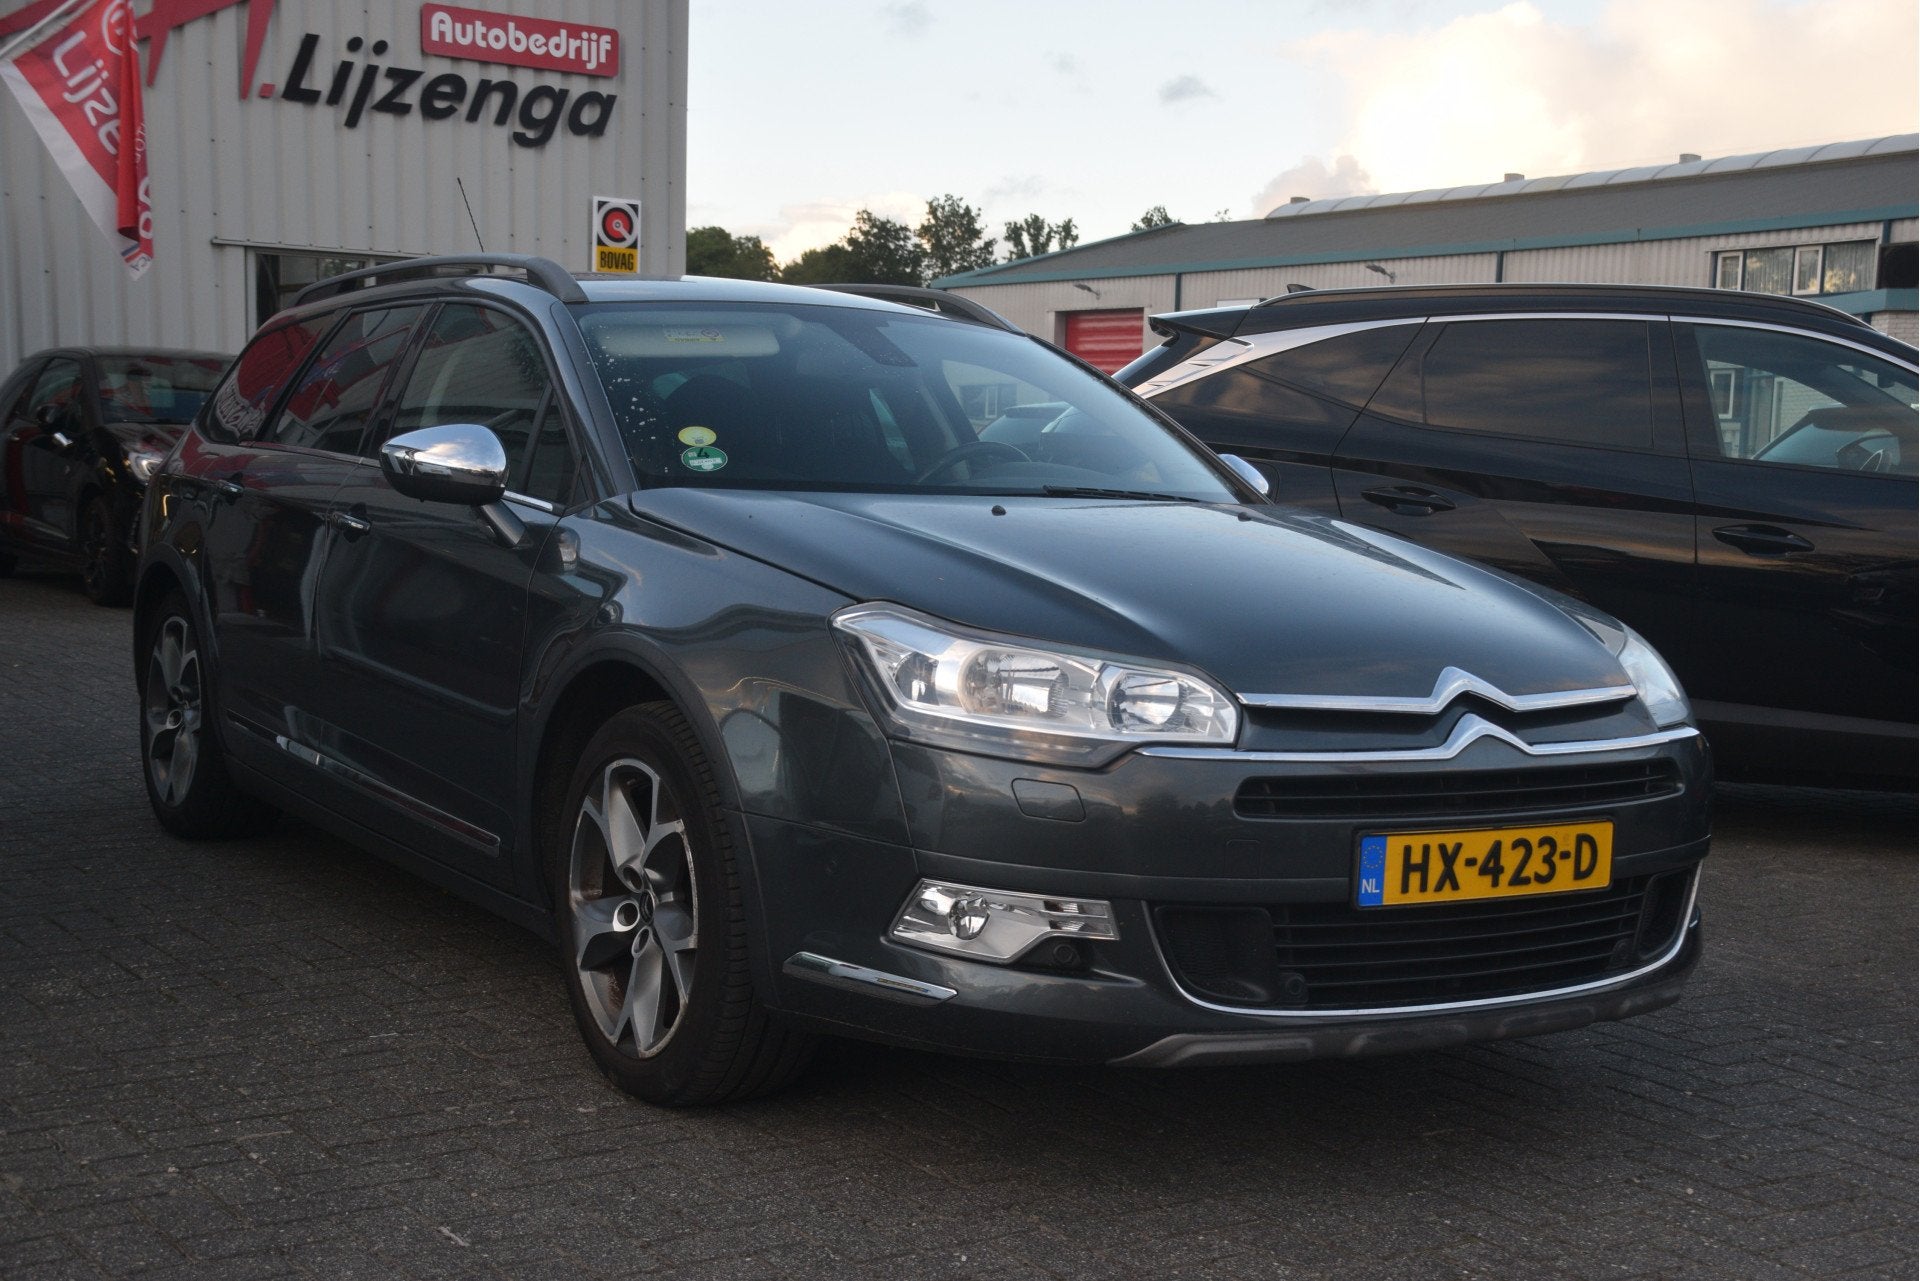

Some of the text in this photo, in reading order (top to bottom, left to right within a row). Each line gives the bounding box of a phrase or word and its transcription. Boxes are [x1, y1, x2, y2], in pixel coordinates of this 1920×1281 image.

[430, 10, 612, 70] Autobedrijf
[280, 32, 618, 149] Lijzenga
[600, 251, 635, 271] BOVAG
[1361, 878, 1380, 894] NL
[1400, 833, 1598, 894] HX-423-D
